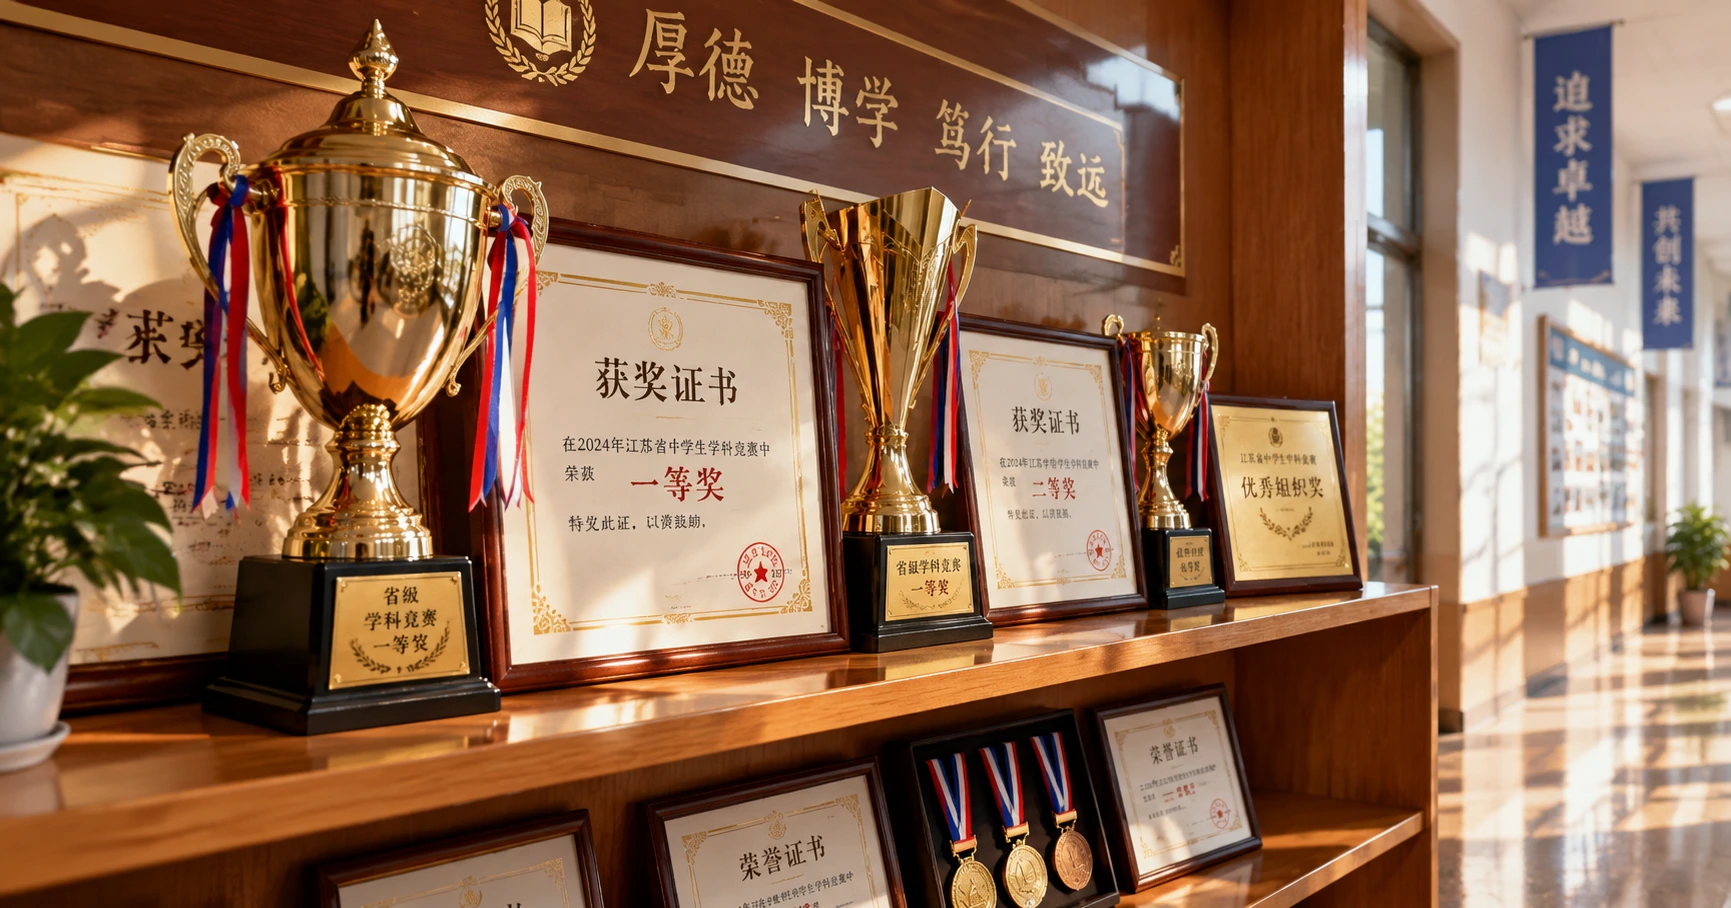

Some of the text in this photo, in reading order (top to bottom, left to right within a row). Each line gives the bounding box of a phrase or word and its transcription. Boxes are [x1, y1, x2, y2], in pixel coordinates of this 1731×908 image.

[629, 8, 1109, 208] 厚德 博学 笃行 致远
[1552, 70, 1594, 246] 追求卓越
[595, 357, 738, 406] 获奖证书
[1011, 406, 1080, 435] 获奖证书
[630, 466, 725, 503] 一等奖
[1032, 476, 1076, 501] 二等奖
[383, 585, 419, 606] 省级
[739, 834, 826, 882] 荣誉证书
